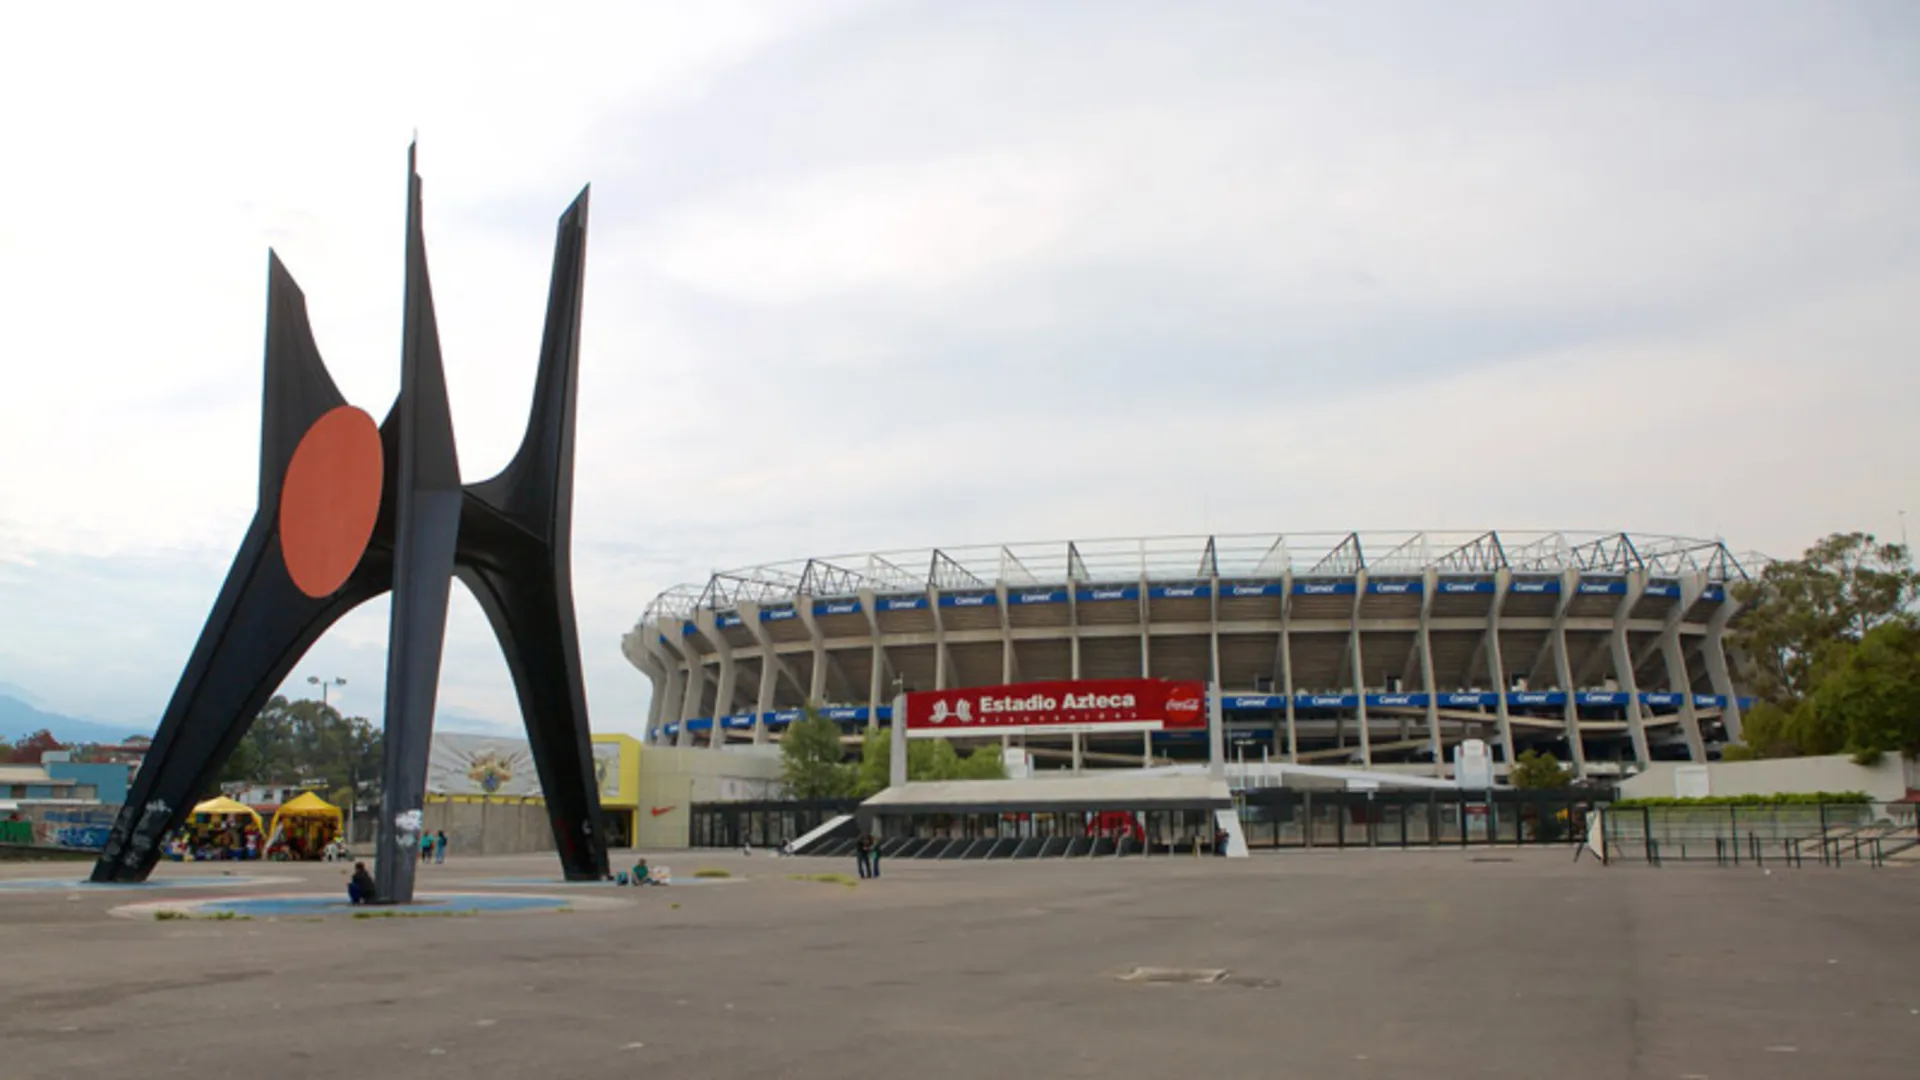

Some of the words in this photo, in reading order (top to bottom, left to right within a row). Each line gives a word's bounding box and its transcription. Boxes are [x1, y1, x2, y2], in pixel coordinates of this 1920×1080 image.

[1233, 585, 1266, 595] Comex
[1304, 584, 1336, 593] Comex
[1376, 583, 1409, 592] Comex
[1445, 582, 1477, 591] Comex
[1092, 590, 1124, 599] Comex
[1164, 587, 1196, 596] Comex
[1021, 593, 1052, 602] Comex
[979, 694, 1056, 713] Estadio
[1062, 692, 1136, 709] Azteca
[1235, 698, 1268, 707] Comex
[1311, 694, 1343, 705] Comex
[1379, 695, 1410, 704] Comex
